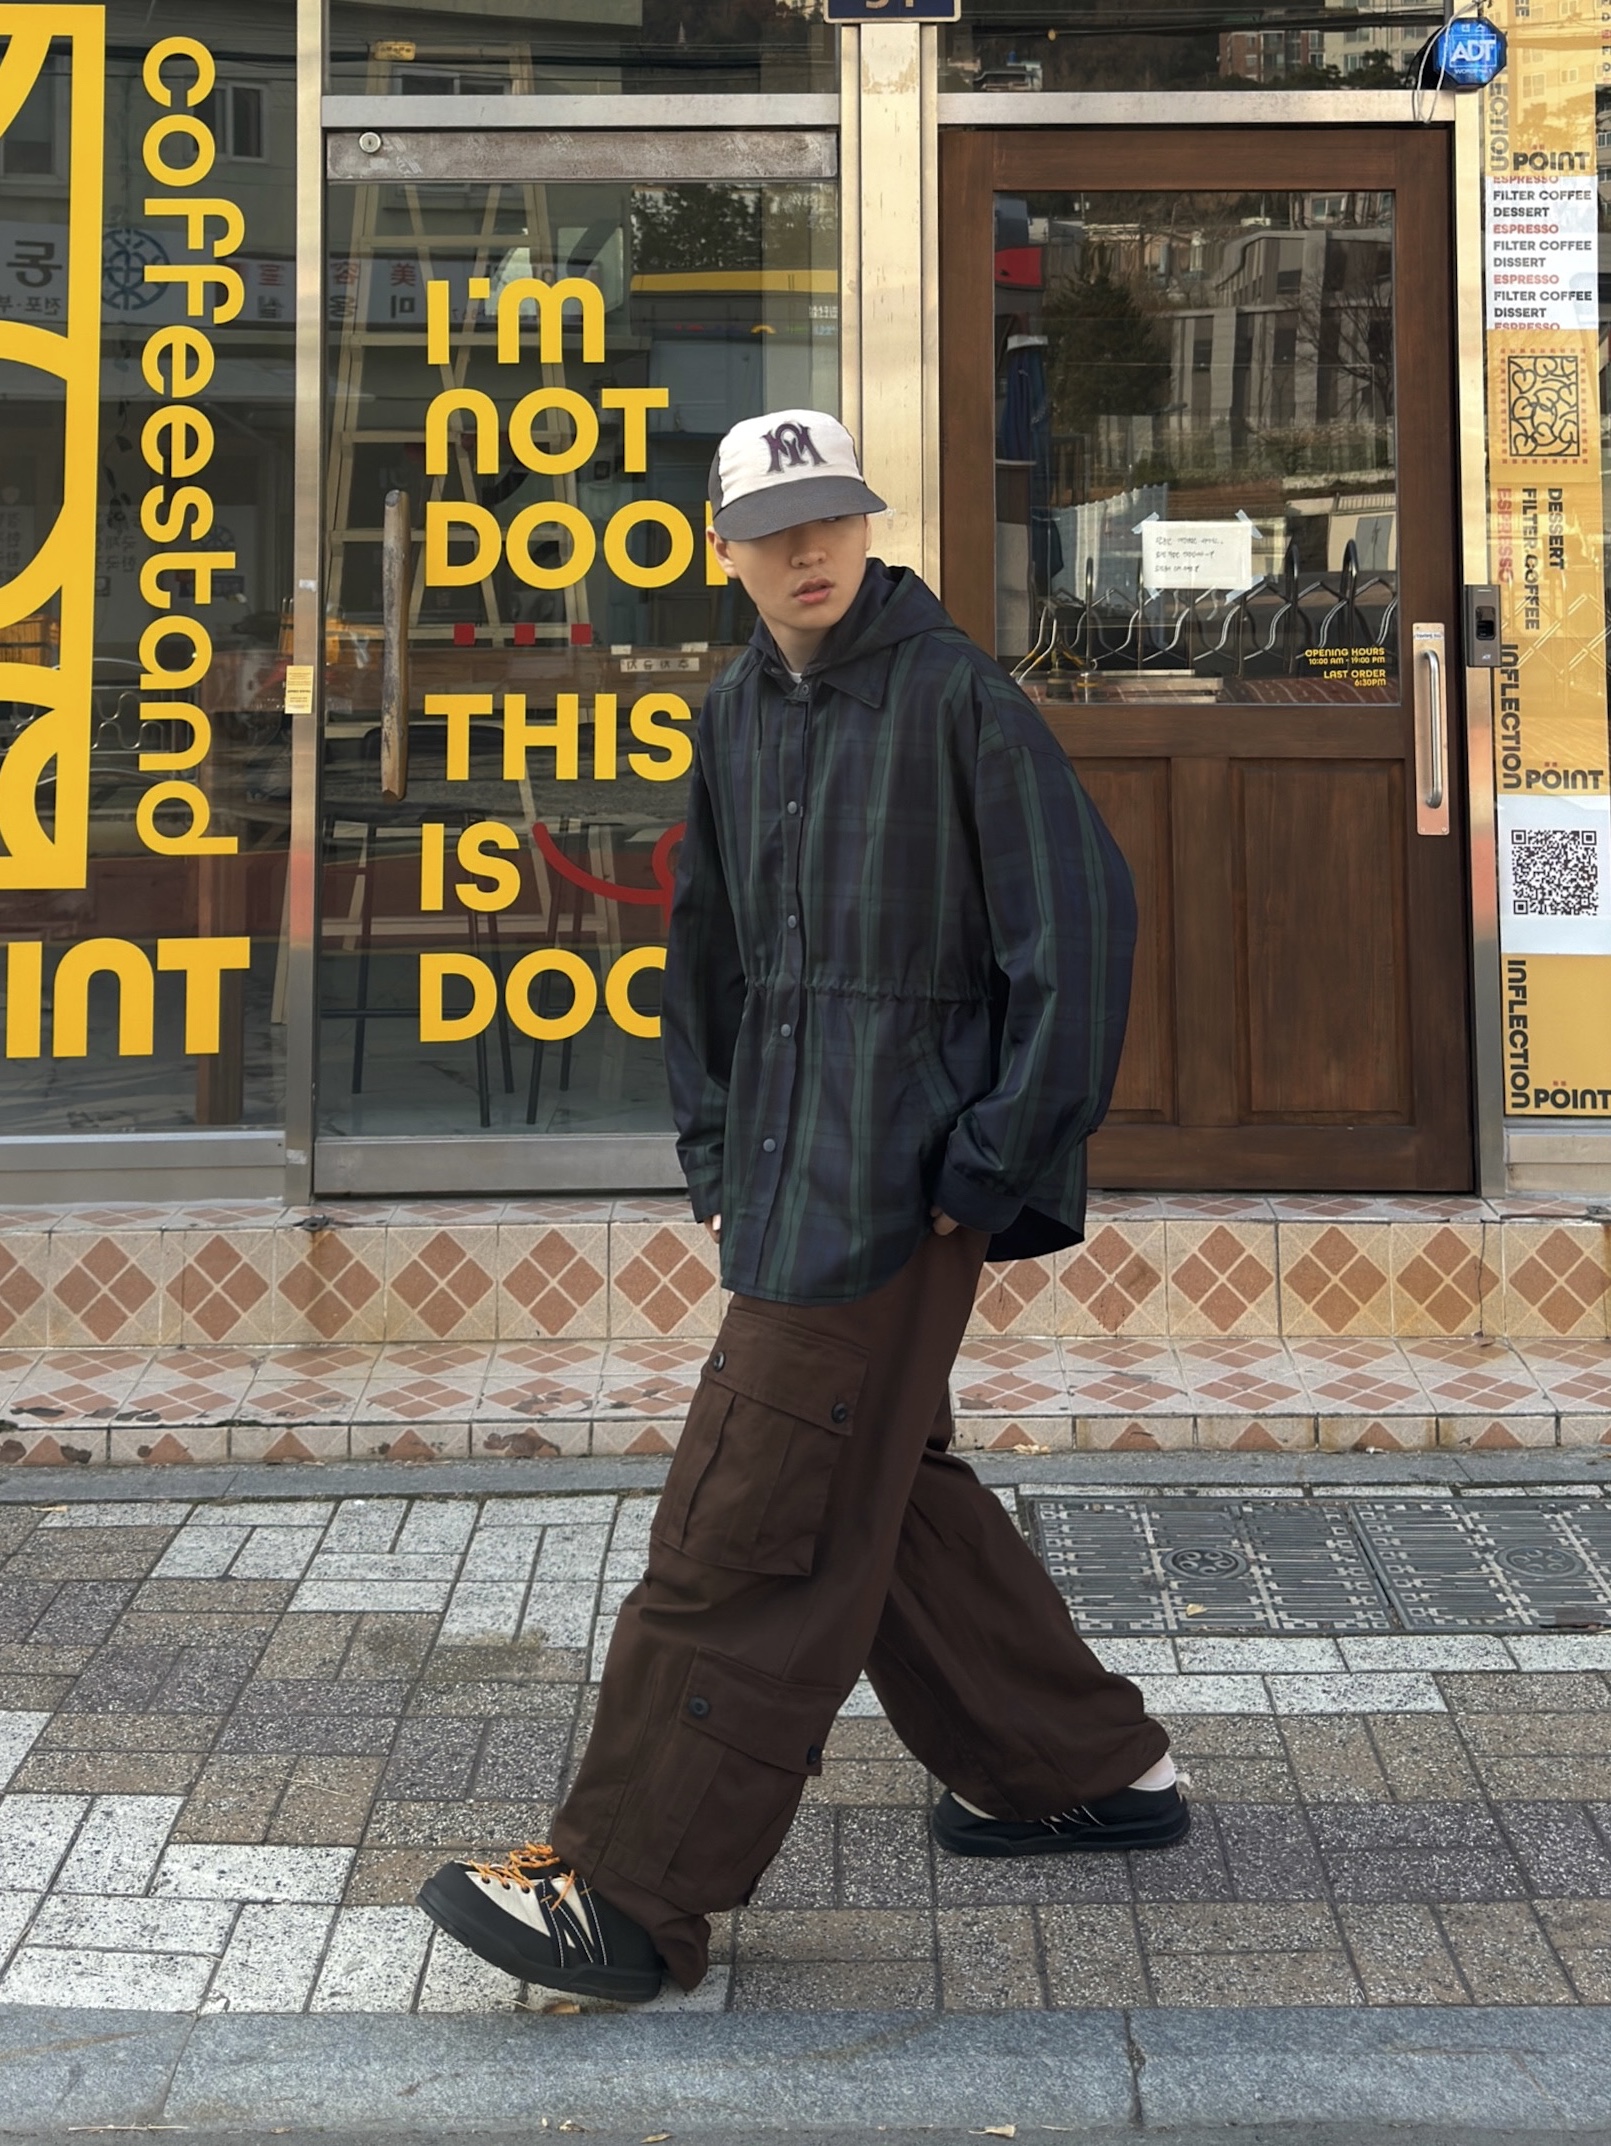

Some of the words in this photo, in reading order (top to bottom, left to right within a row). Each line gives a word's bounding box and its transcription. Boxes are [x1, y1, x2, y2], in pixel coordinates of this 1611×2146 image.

[1450, 39, 1496, 62] ADT
[1493, 190, 1535, 200] FILTER
[1539, 190, 1592, 200] COFFEE
[1493, 207, 1550, 217] DESSERT
[1493, 224, 1559, 234] ESPRESSO
[1493, 241, 1536, 251] FILTER
[1539, 241, 1592, 251] COFFEE
[1494, 257, 1546, 268] DISSERT
[1494, 274, 1560, 285] ESPRESSO
[1494, 291, 1536, 301] FILTER
[1540, 291, 1593, 301] COFFEE
[1494, 307, 1547, 318] DISSERT
[136, 36, 246, 856] coffeestand
[1522, 488, 1538, 549] FILTER
[1548, 488, 1564, 570] DESSERT
[1497, 488, 1513, 584] ESPRESSO
[1524, 554, 1540, 630] COFFEE
[1305, 648, 1348, 657] OPENING
[1351, 647, 1385, 656] HOURS
[1330, 657, 1344, 665] AM
[1372, 656, 1386, 664] PM
[1324, 670, 1348, 679] LAST
[1351, 669, 1386, 678] ORDER
[1500, 644, 1522, 789] INFLECTION
[424, 692, 693, 781] THIS
[420, 821, 521, 912] IS
[1507, 960, 1530, 1109] INFLECTION
